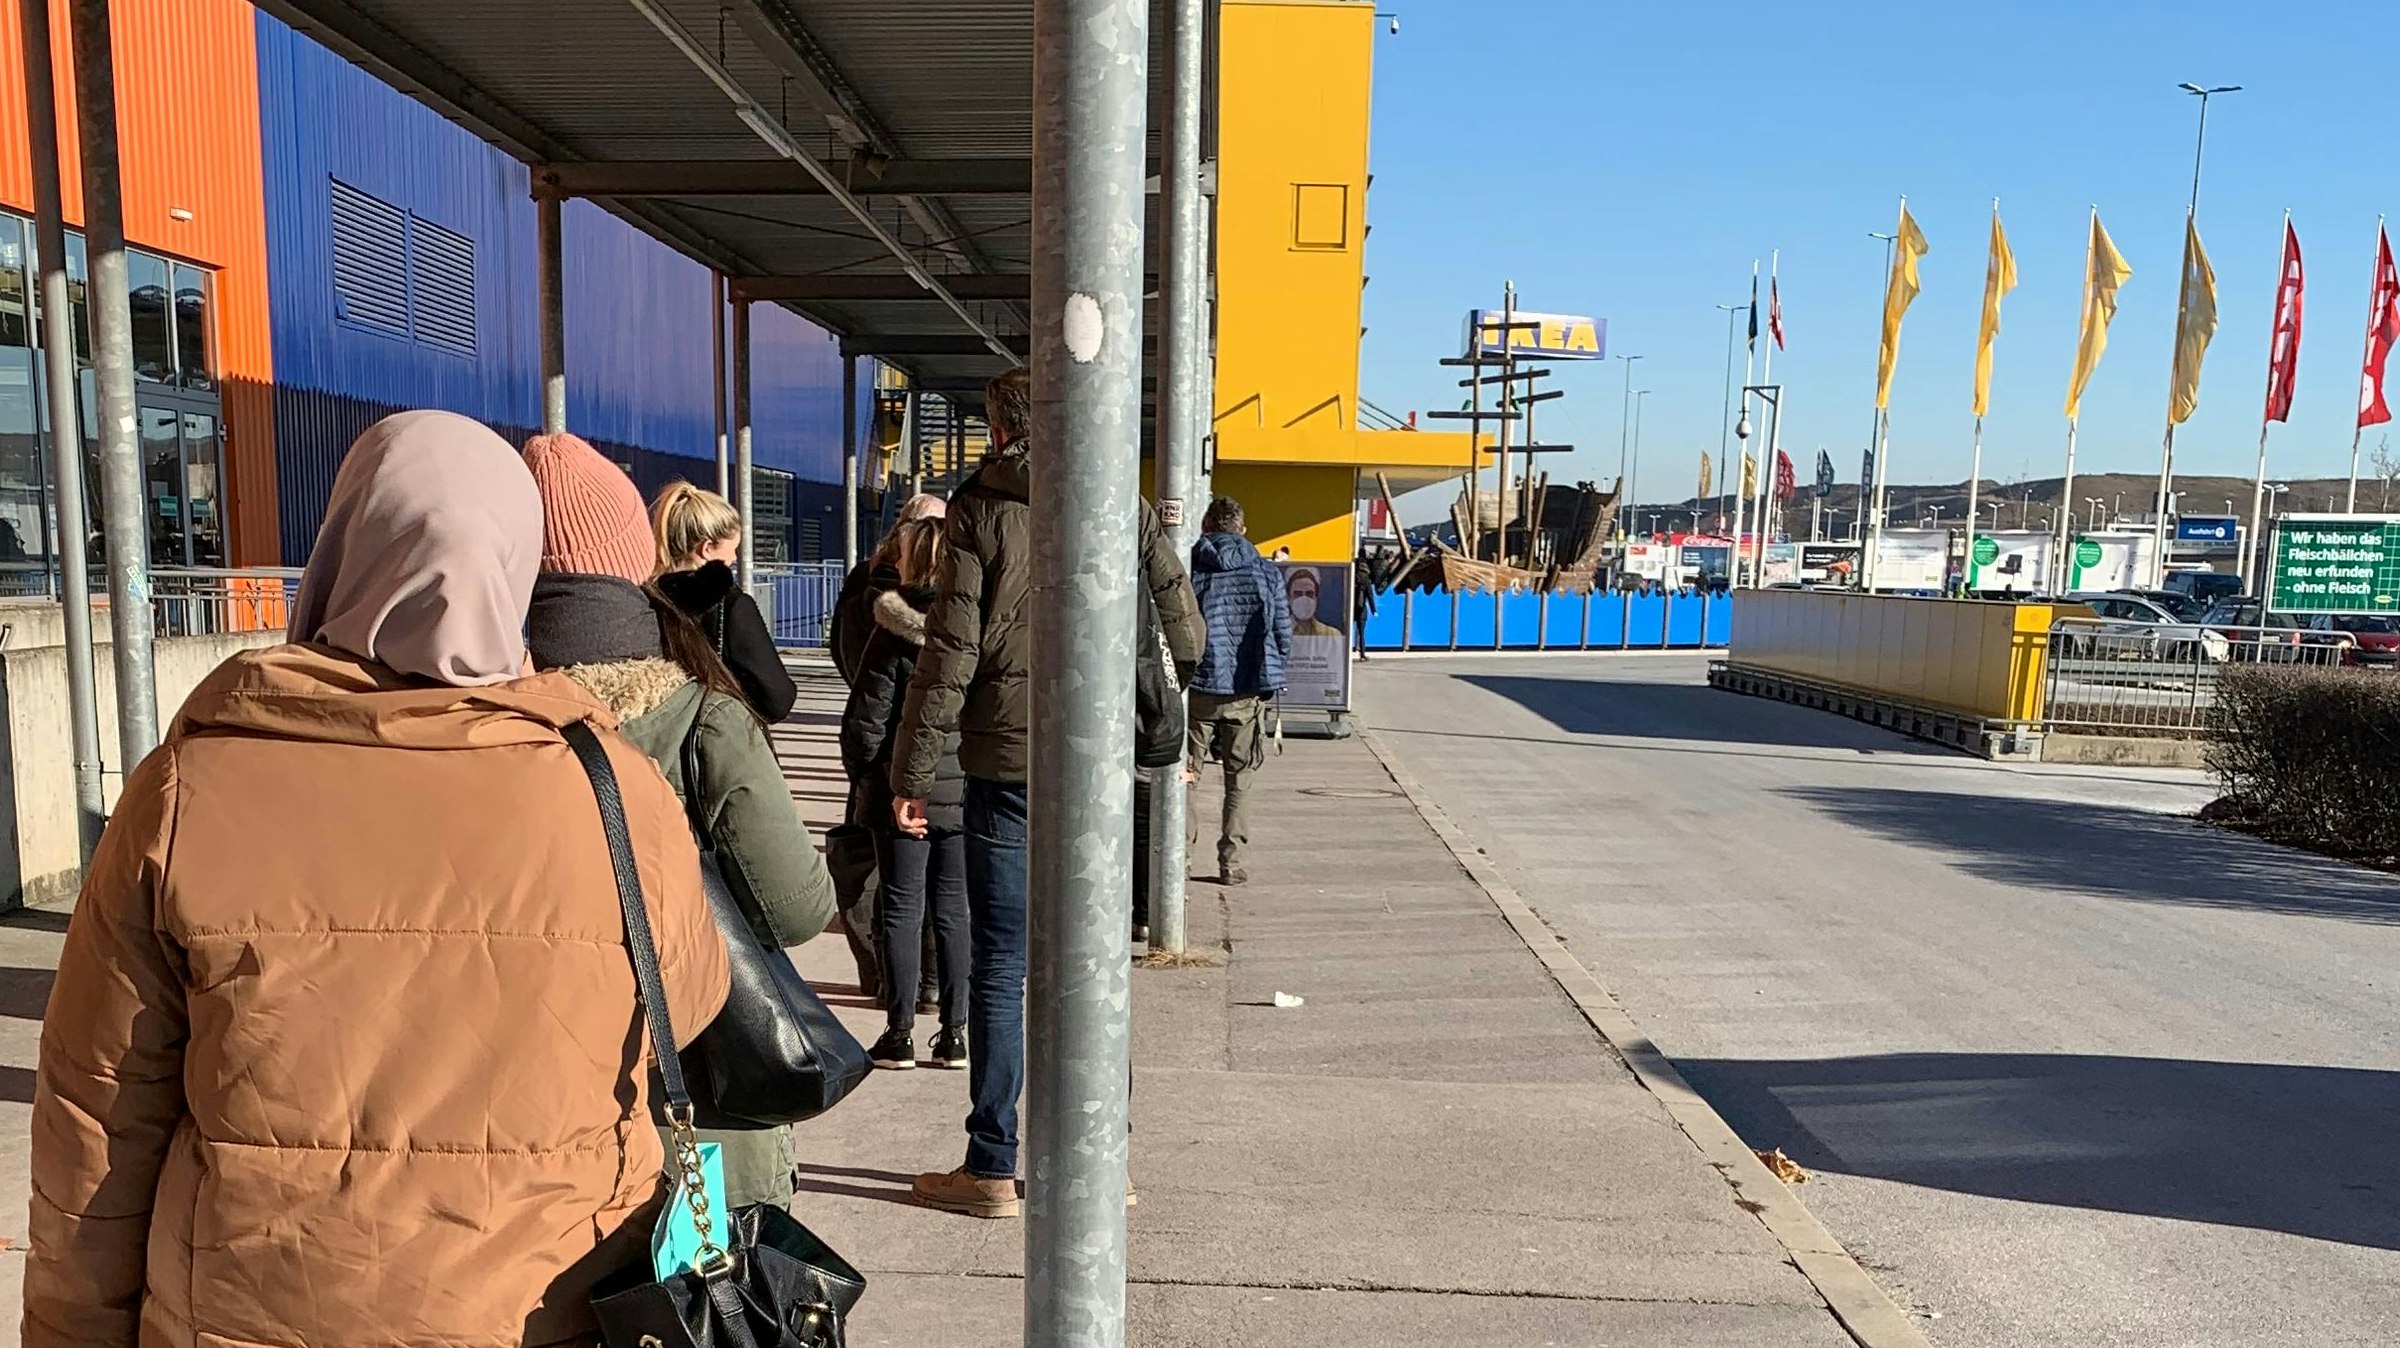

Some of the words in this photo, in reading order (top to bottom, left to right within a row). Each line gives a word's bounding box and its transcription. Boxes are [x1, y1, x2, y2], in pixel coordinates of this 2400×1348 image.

[2290, 531, 2314, 544] Wir
[2316, 531, 2357, 545] haben
[2359, 532, 2382, 545] das
[2288, 548, 2384, 562] Fleischbällchen
[2287, 566, 2312, 577] neu
[2314, 564, 2374, 578] erfunden
[2292, 580, 2326, 593] ohne
[2328, 581, 2371, 595] Fleisch
